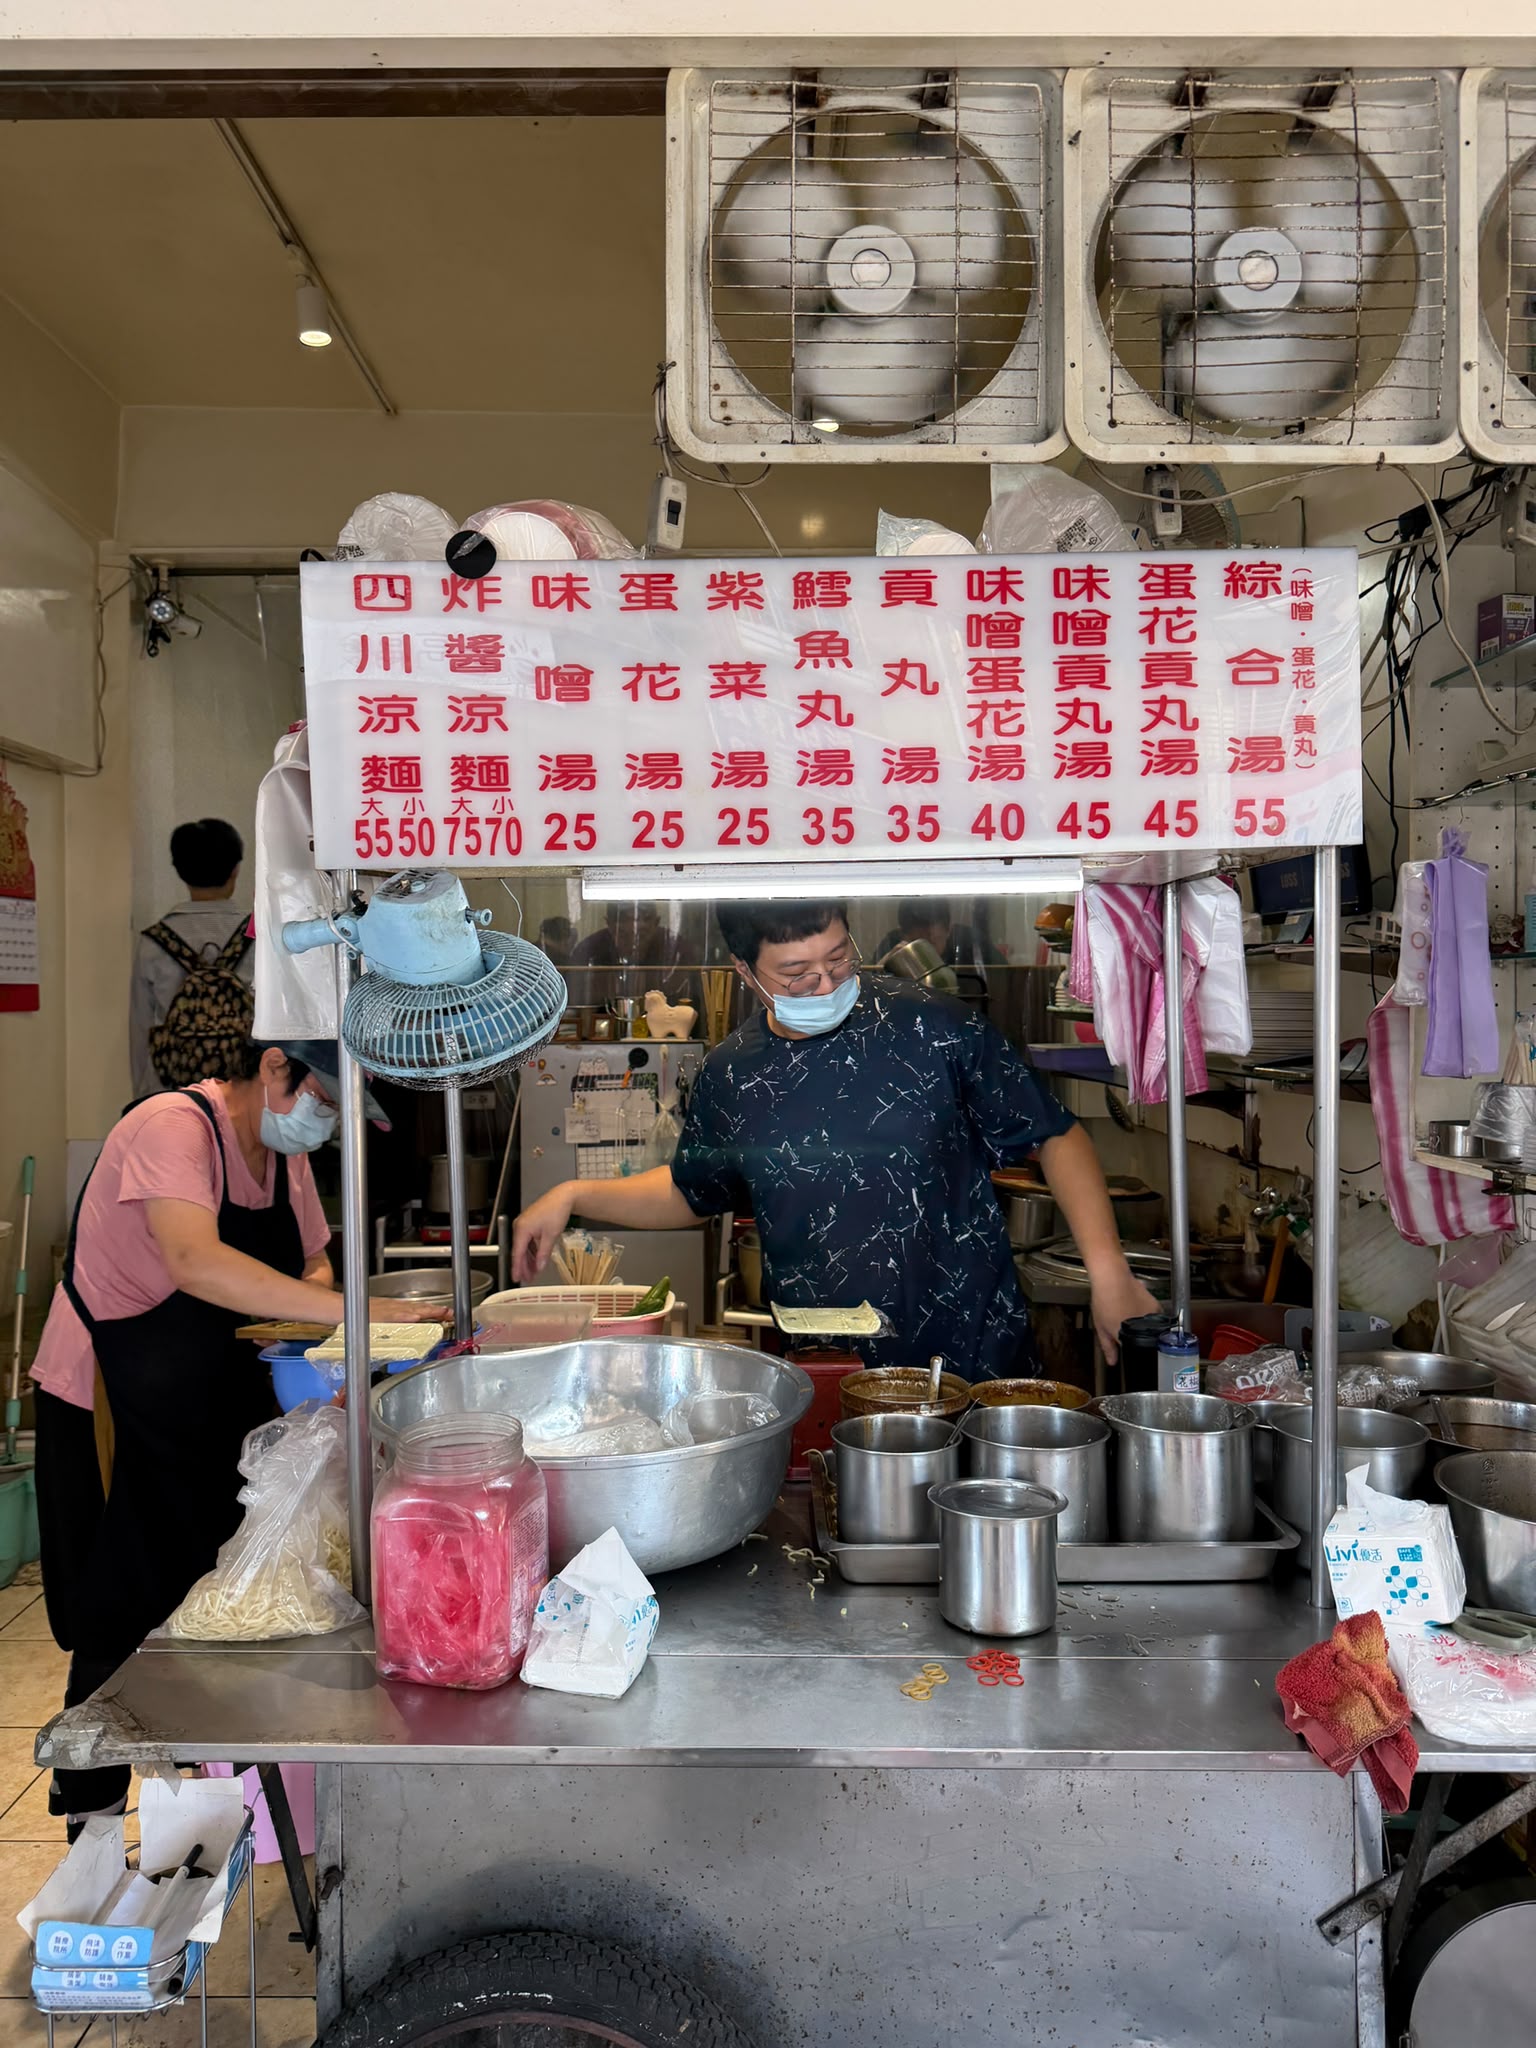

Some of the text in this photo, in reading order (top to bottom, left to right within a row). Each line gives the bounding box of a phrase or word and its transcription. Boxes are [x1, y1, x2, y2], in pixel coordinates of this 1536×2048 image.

[353, 574, 423, 795] 四川涼麵
[441, 575, 511, 794] 炸醬涼麵
[532, 572, 597, 791] 味噌湯
[619, 573, 683, 790] 蛋花湯
[706, 571, 769, 789] 紫菜湯
[792, 571, 854, 787] 鱈魚丸湯
[879, 569, 940, 784] 貢丸湯
[966, 566, 1026, 782] 味噌蛋花湯
[1052, 564, 1112, 779] 味噌貢丸湯
[1138, 563, 1199, 777] 蛋花貢丸湯
[1224, 561, 1286, 773] 綜合湯
[362, 796, 425, 816] 大 小
[451, 796, 514, 816] 大 小
[887, 805, 940, 843] 35
[971, 803, 1025, 841] 40
[1057, 802, 1111, 840] 45
[1144, 800, 1198, 838] 45
[1234, 798, 1285, 836] 55
[544, 813, 597, 851] 25
[632, 810, 684, 849] 25
[718, 808, 770, 846] 25
[802, 807, 854, 846] 35
[1325, 1540, 1358, 1562] Livi
